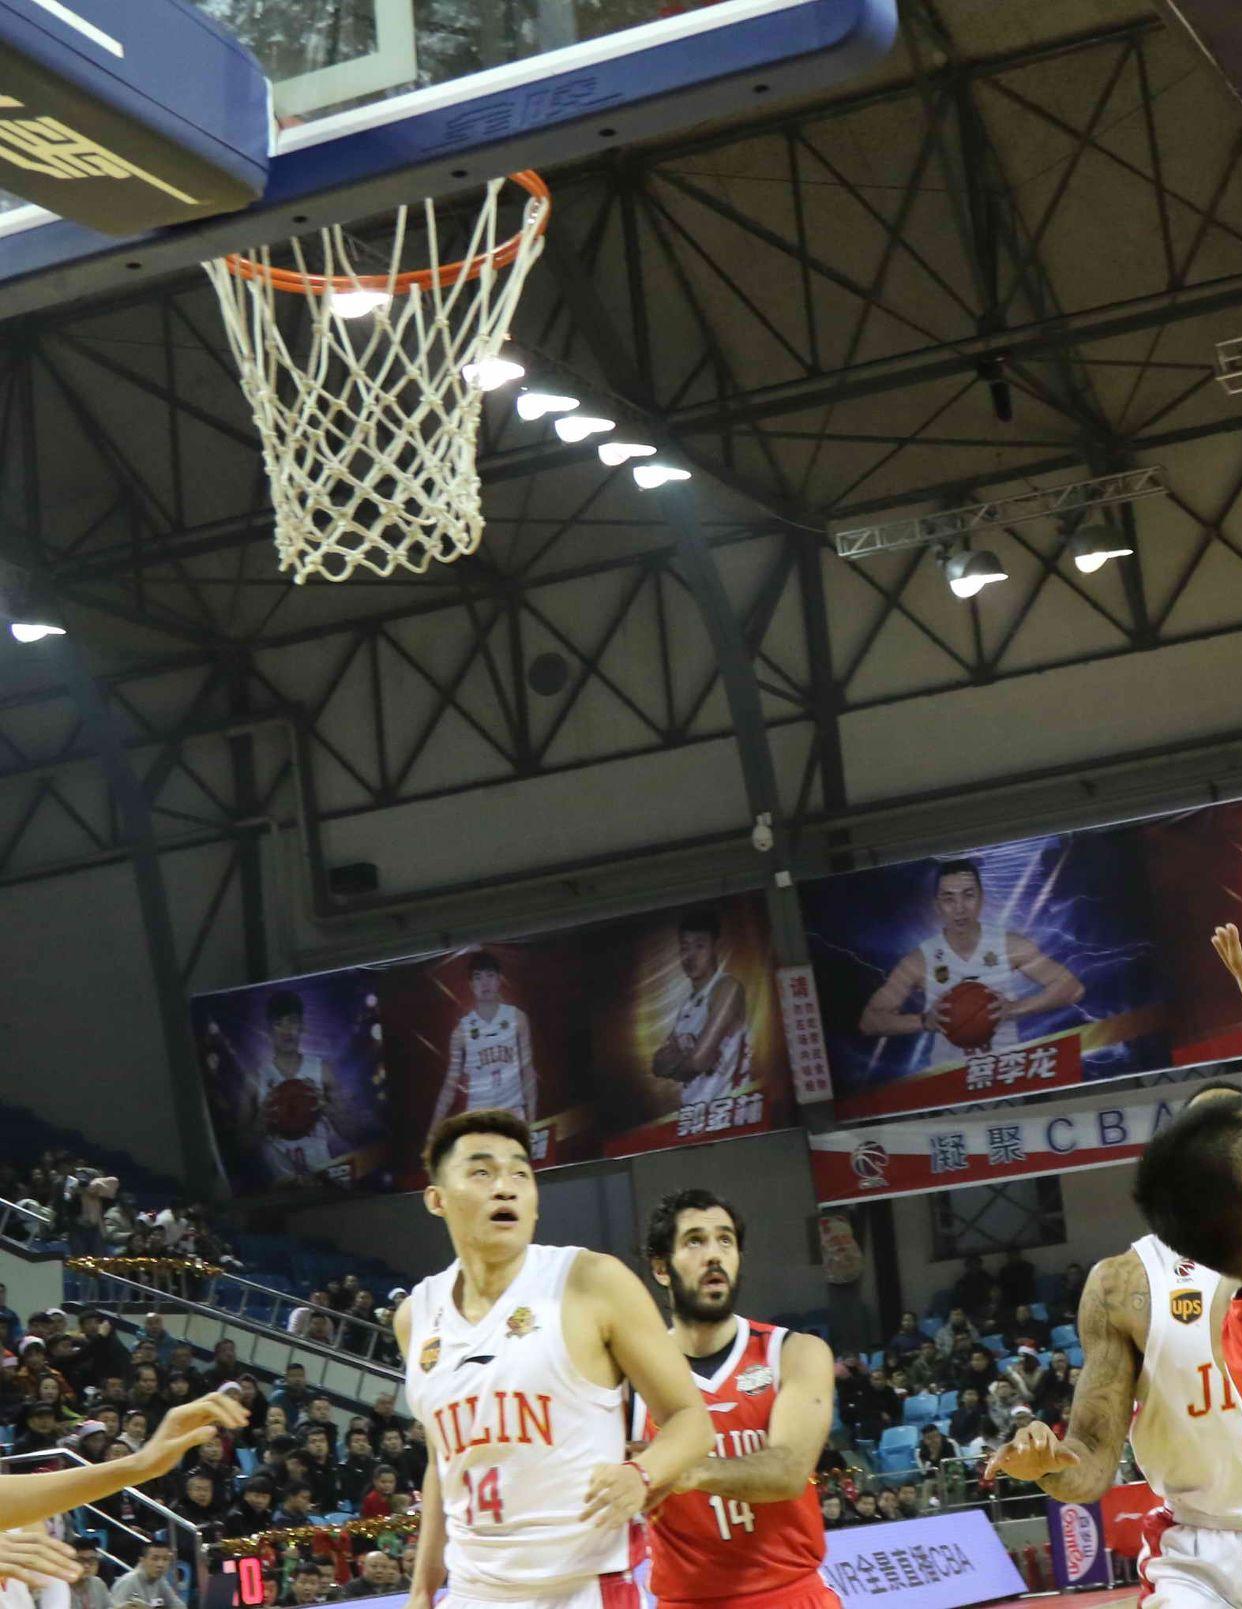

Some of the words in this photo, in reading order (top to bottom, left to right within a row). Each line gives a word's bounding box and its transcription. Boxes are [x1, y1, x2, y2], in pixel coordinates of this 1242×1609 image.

[1172, 1299, 1203, 1321] ups
[433, 1390, 555, 1462] JILIN
[462, 1467, 504, 1526] 14
[708, 1494, 756, 1542] 14
